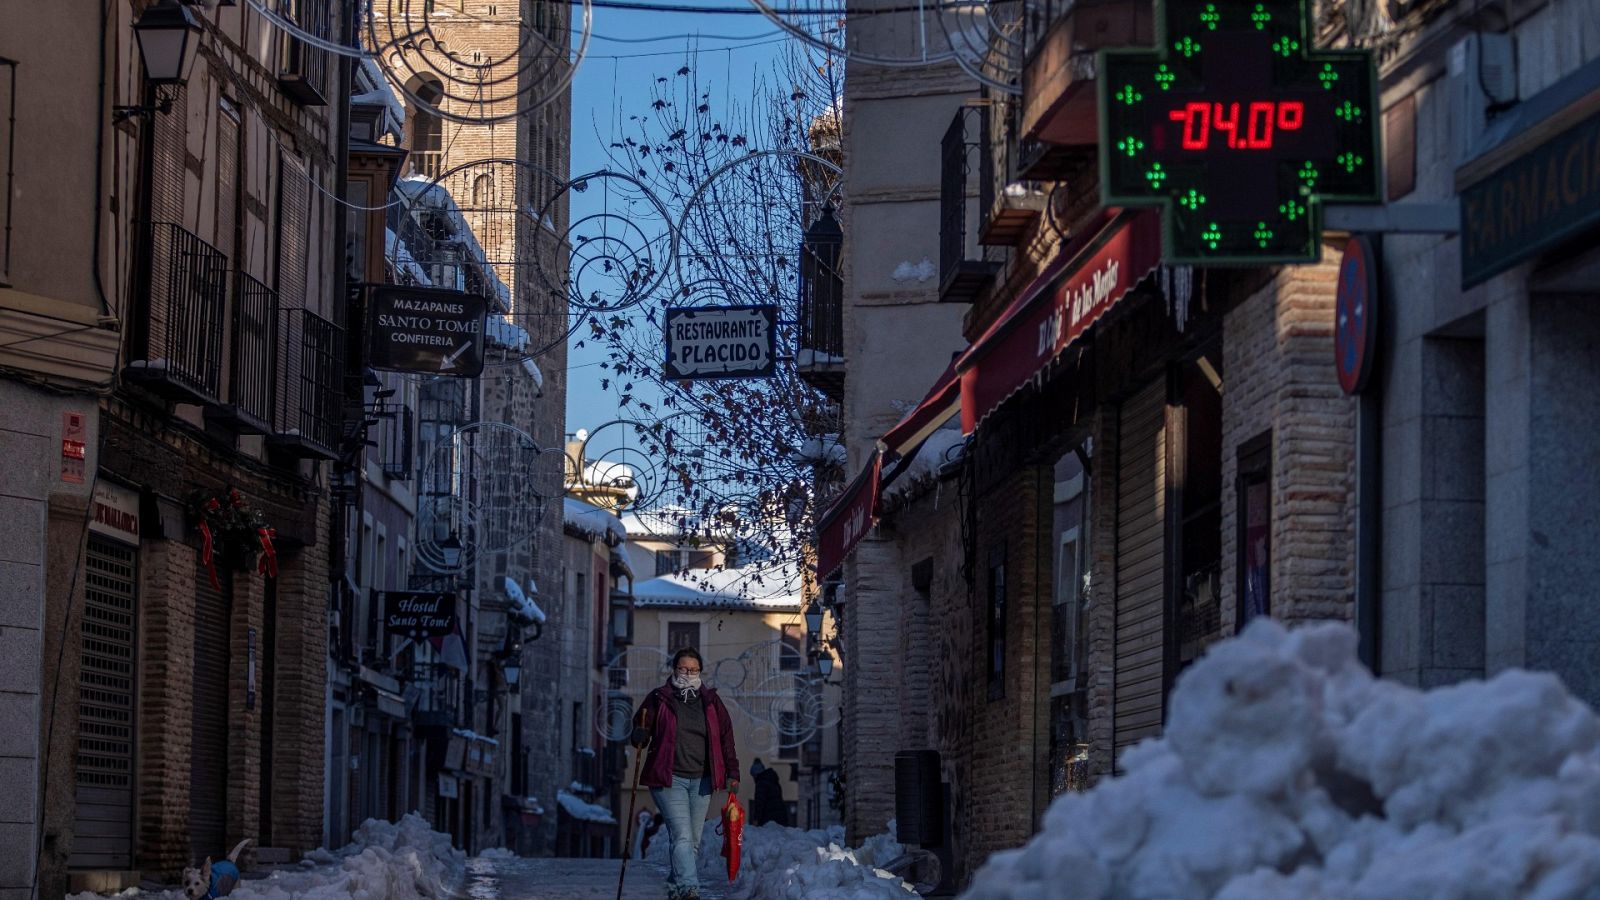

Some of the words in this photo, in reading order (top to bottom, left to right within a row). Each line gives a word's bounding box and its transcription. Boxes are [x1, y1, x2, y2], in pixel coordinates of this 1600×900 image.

[394, 299, 464, 314] MAZAPANES
[379, 314, 431, 330] SANTO
[436, 320, 479, 333] TOMÉ
[676, 320, 762, 341] RESTAURANTE
[391, 333, 454, 346] CONFITERIA
[682, 342, 761, 363] PLACIDO
[398, 595, 444, 613] Hostal
[388, 614, 418, 627] Santo
[420, 615, 452, 628] Tomé
